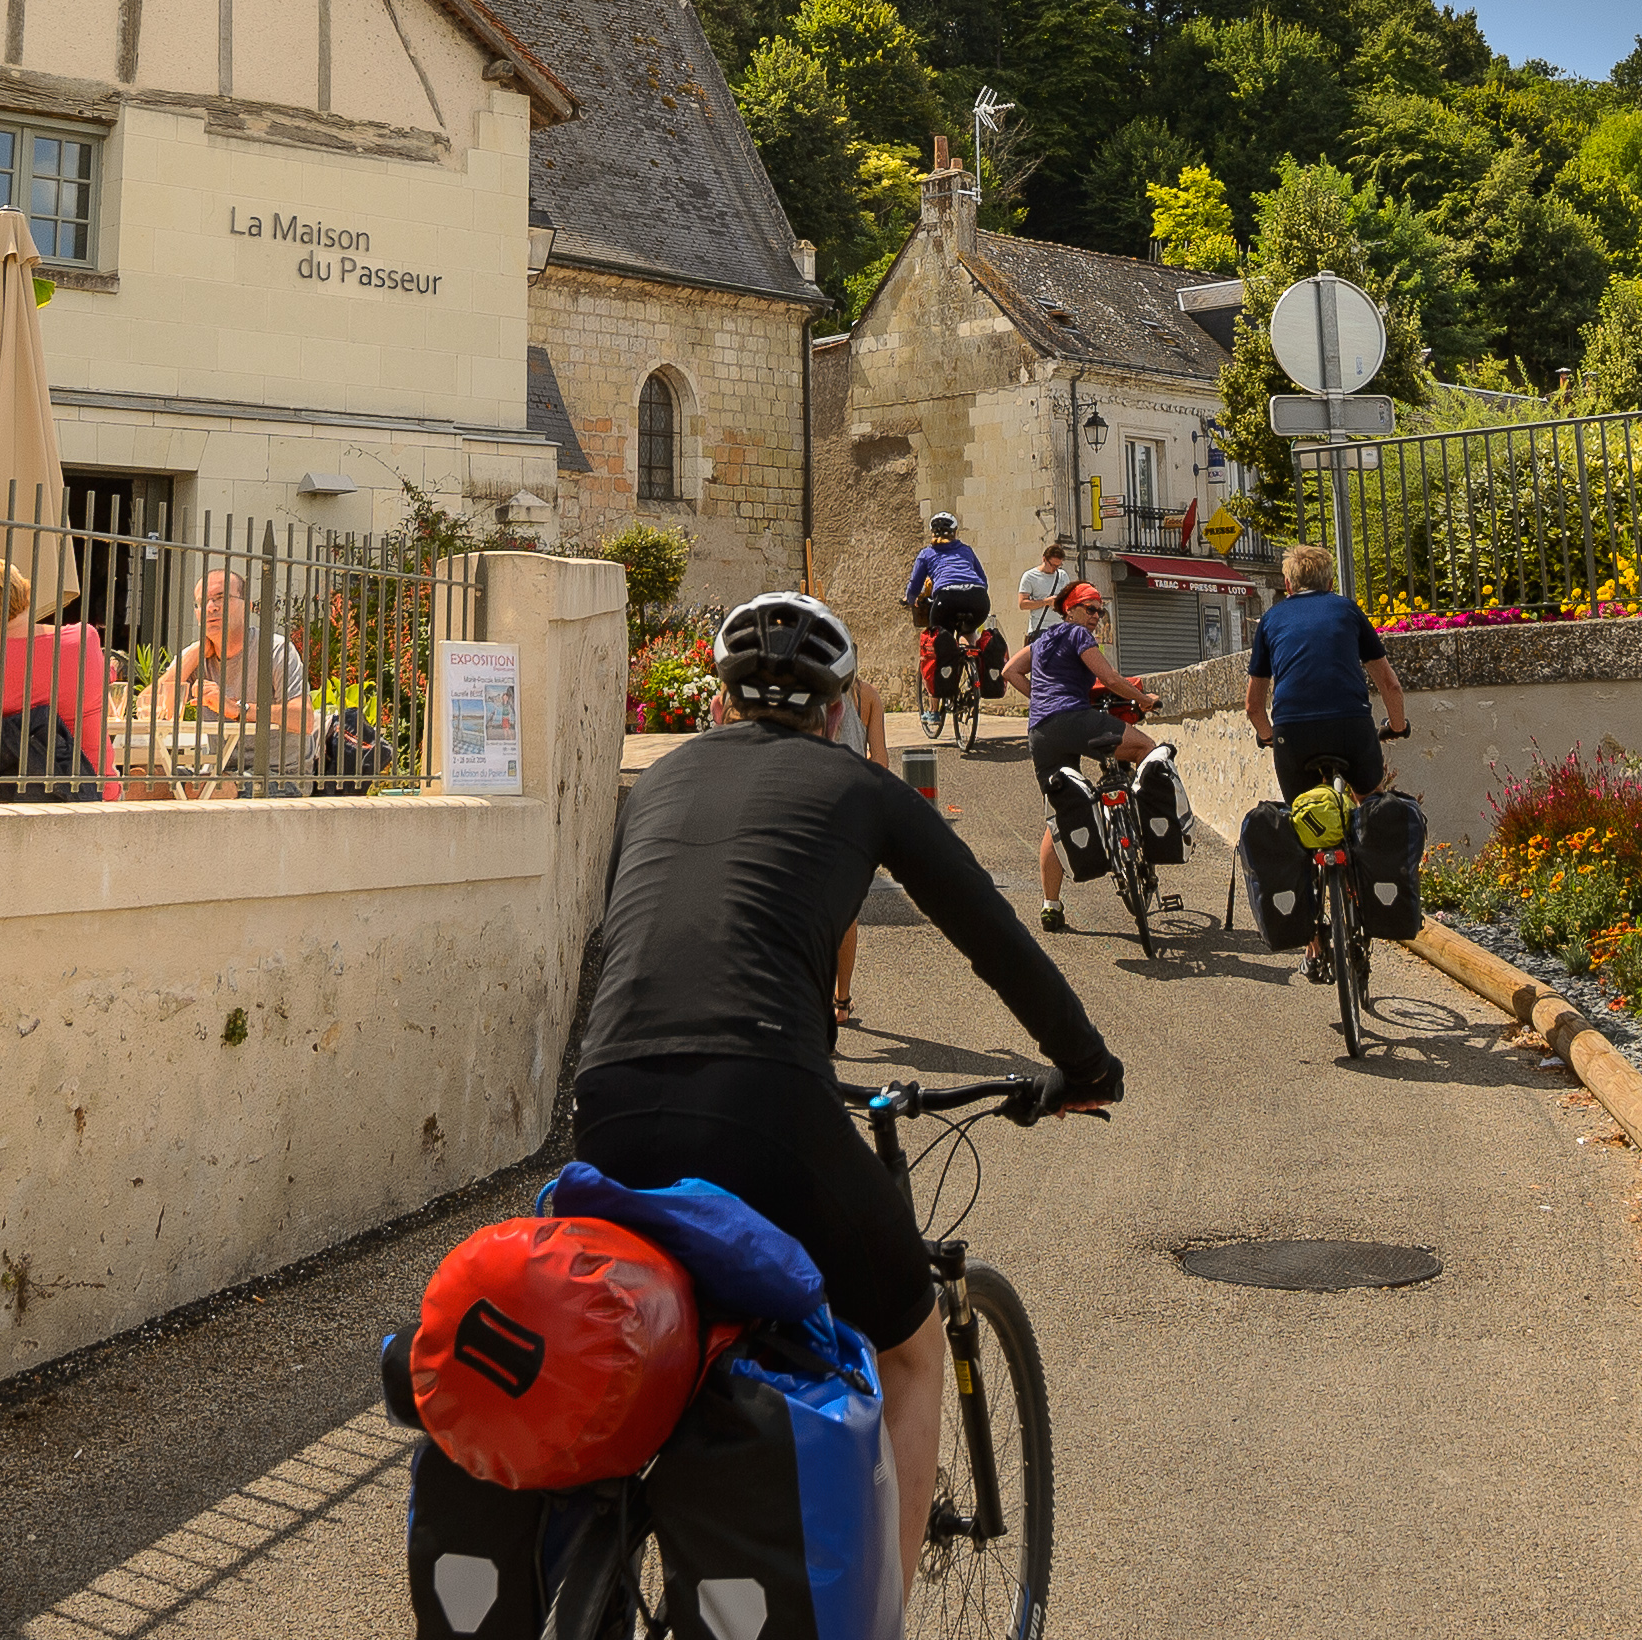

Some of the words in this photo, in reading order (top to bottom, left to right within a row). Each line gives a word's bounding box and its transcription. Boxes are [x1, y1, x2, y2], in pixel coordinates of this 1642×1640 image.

[229, 206, 262, 237] La
[272, 212, 371, 252] Maison
[297, 250, 332, 281] du
[339, 256, 443, 295] Passeur
[1204, 526, 1237, 536] PRESSE
[1154, 579, 1179, 590] TABAC
[1189, 582, 1218, 593] PRESSE
[1227, 586, 1247, 595] LOTO
[450, 653, 515, 667] EXPOSITION
[1028, 1603, 1041, 1640] GIA
